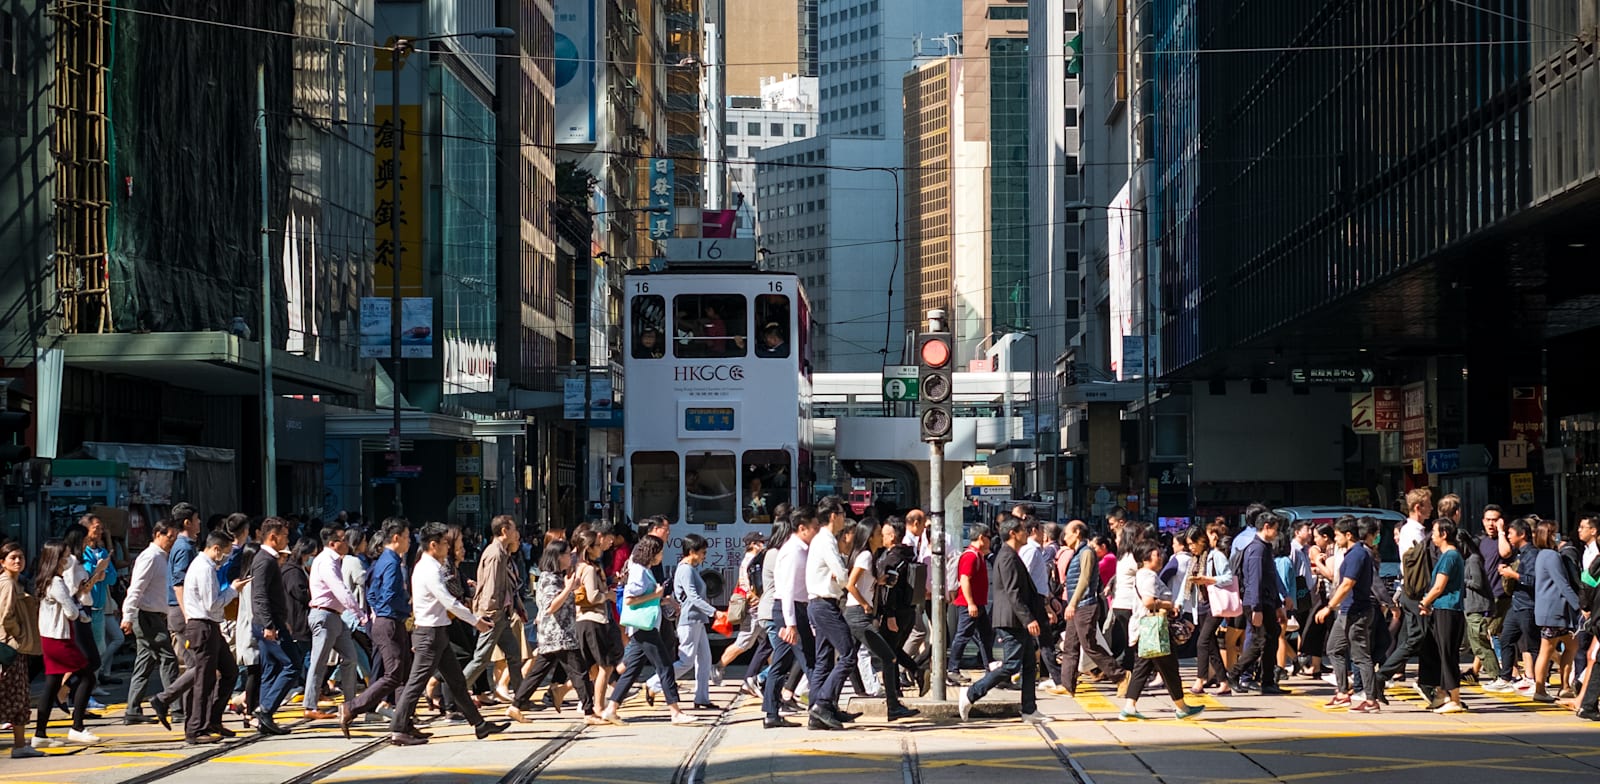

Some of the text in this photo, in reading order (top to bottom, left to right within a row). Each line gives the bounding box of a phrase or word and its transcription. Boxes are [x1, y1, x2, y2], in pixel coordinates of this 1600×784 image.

[697, 240, 722, 260] 16
[635, 282, 649, 293] 16
[768, 281, 783, 292] 16
[674, 365, 744, 381] HKGCC
[1503, 444, 1522, 457] FT
